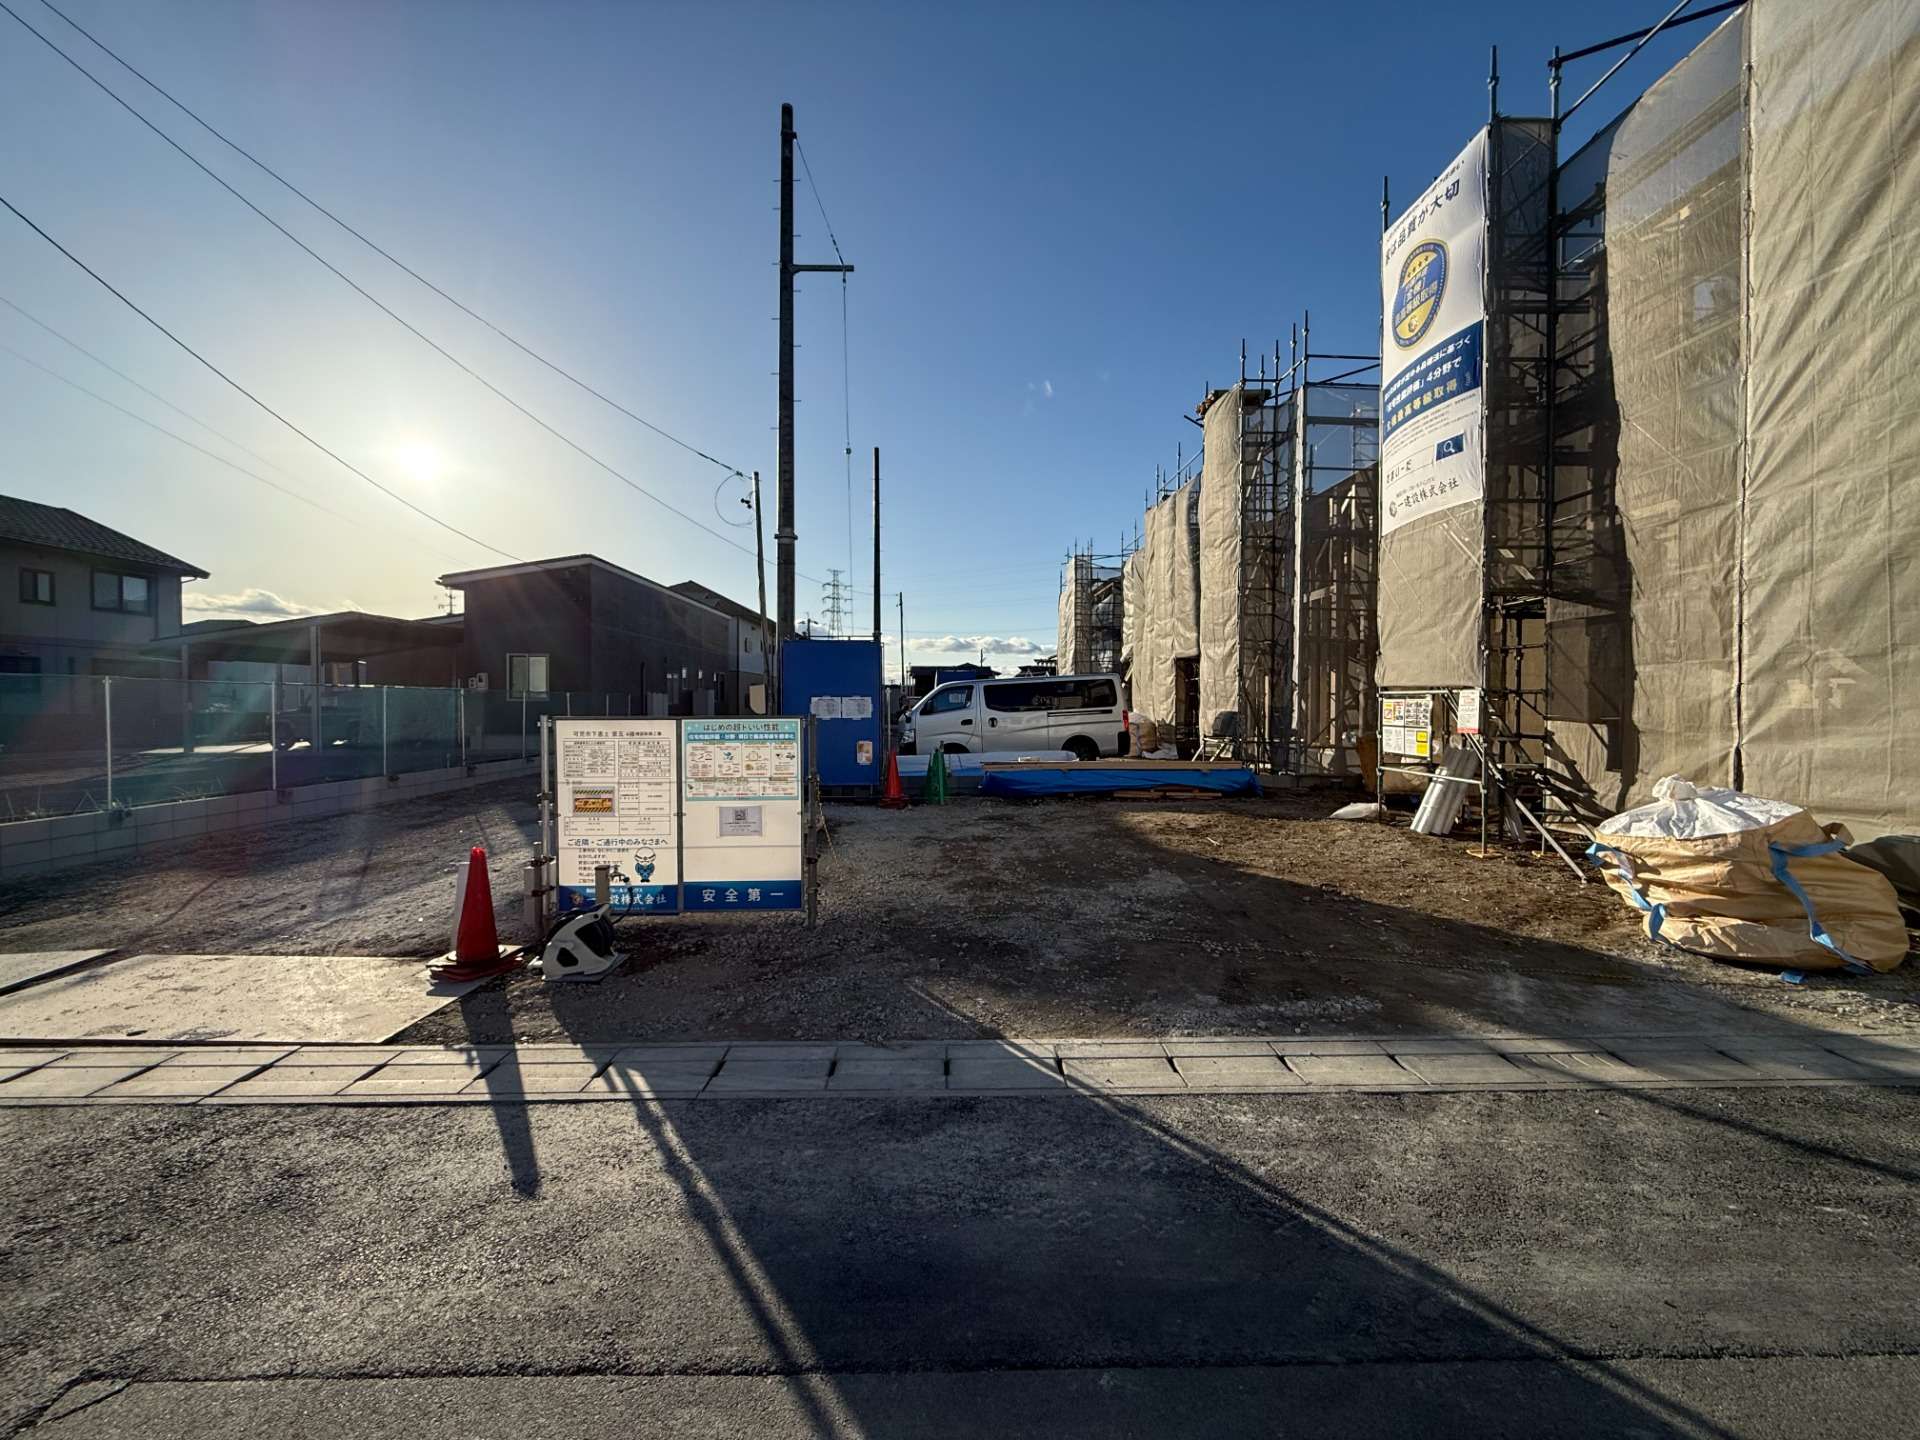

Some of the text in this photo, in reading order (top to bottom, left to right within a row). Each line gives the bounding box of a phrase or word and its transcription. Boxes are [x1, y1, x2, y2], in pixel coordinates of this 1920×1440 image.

[1397, 478, 1460, 508] 一建設株式会社
[586, 893, 668, 905] 一設株式会社
[702, 888, 784, 903] 安全第一
